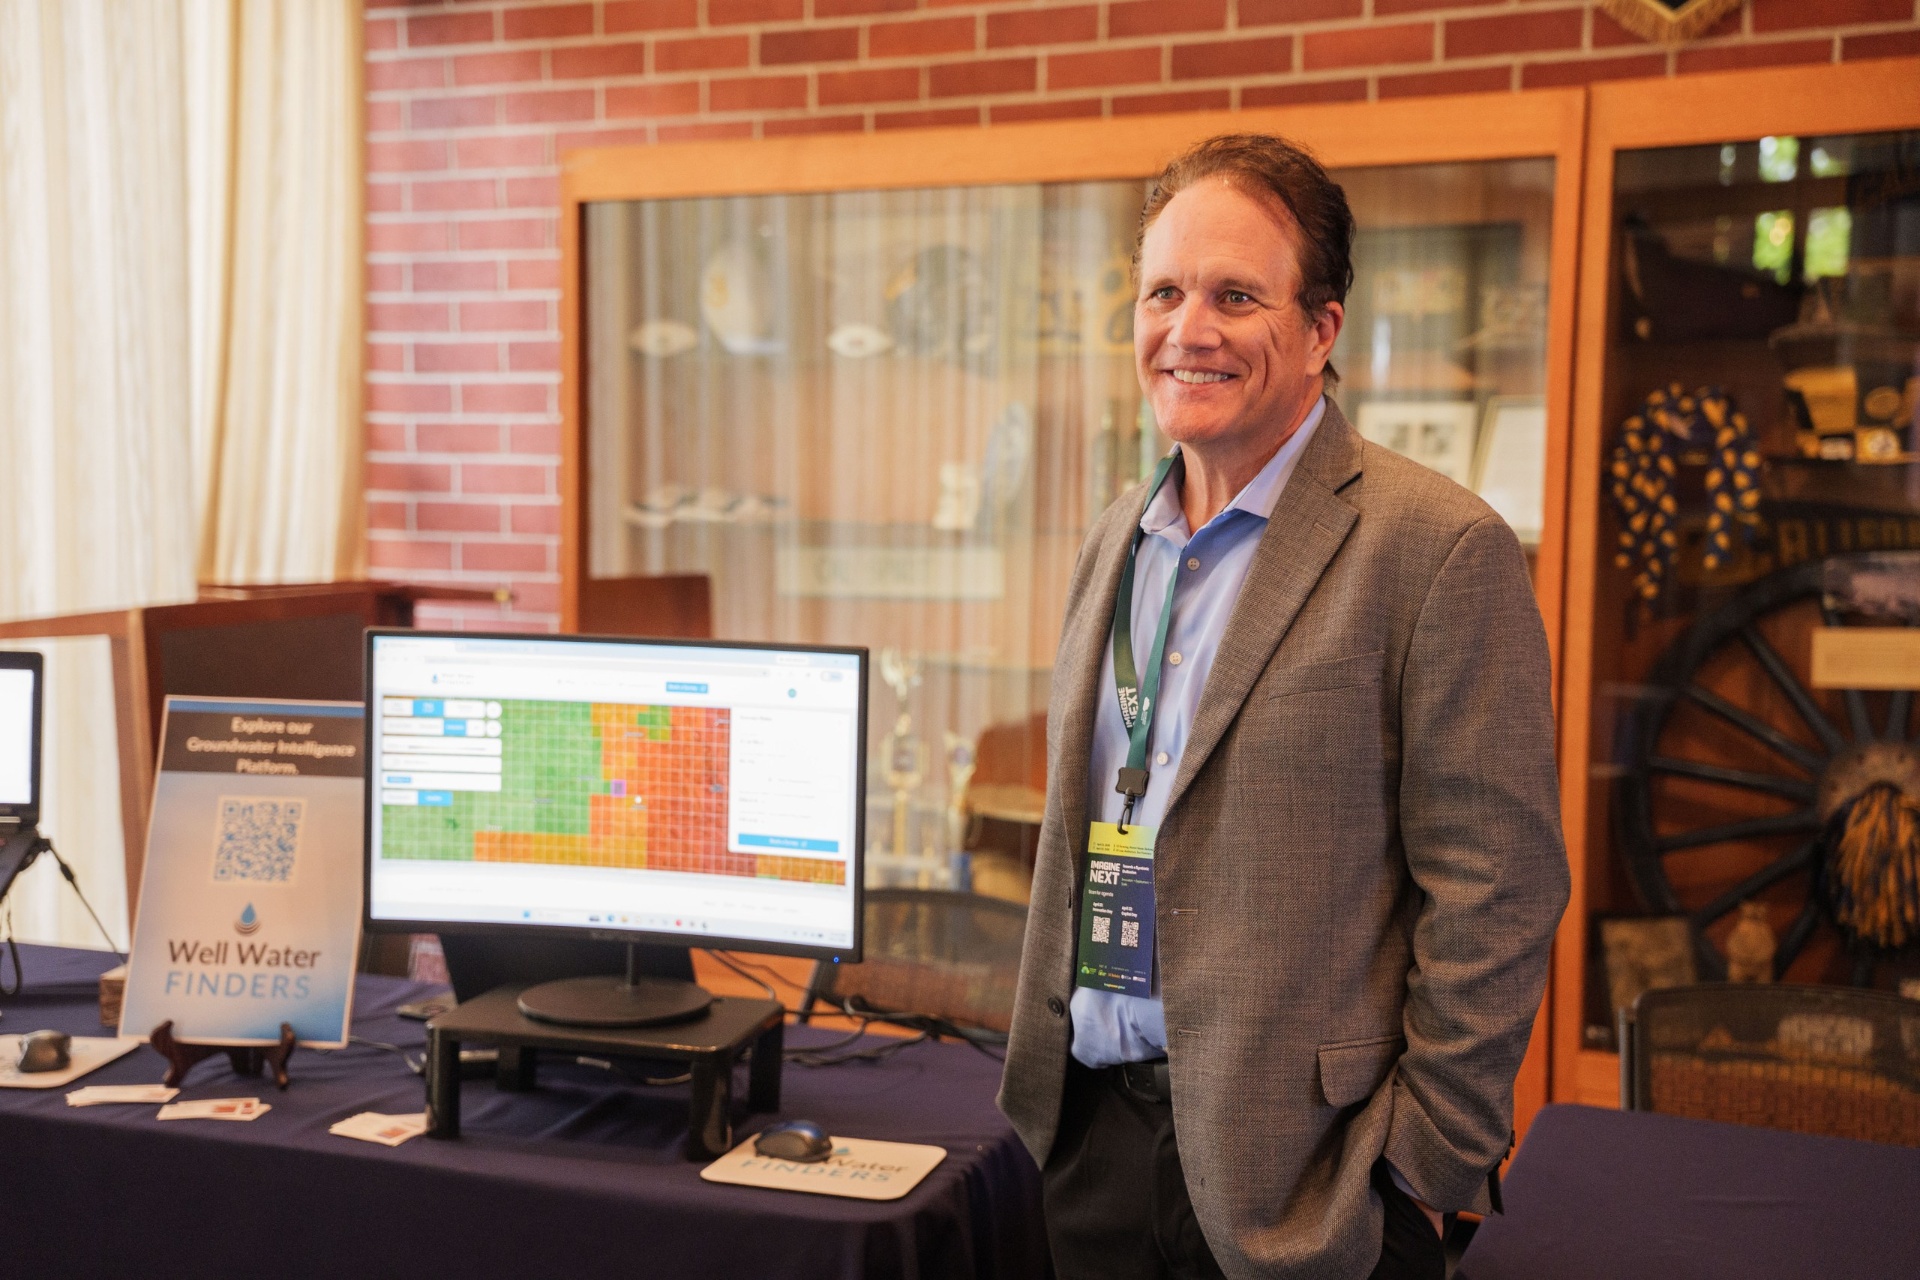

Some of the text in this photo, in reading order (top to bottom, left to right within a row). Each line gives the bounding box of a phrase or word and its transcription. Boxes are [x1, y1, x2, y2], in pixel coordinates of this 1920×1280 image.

[1118, 687, 1133, 728] IMAGINE
[231, 716, 314, 735] Explore our
[186, 736, 356, 758] Groundwater Intelligence
[1089, 869, 1120, 885] NEXT
[1090, 860, 1121, 872] IMAGINE
[168, 939, 322, 968] Well Water
[165, 970, 312, 999] FINDERS
[740, 1159, 891, 1182] FINDERS
